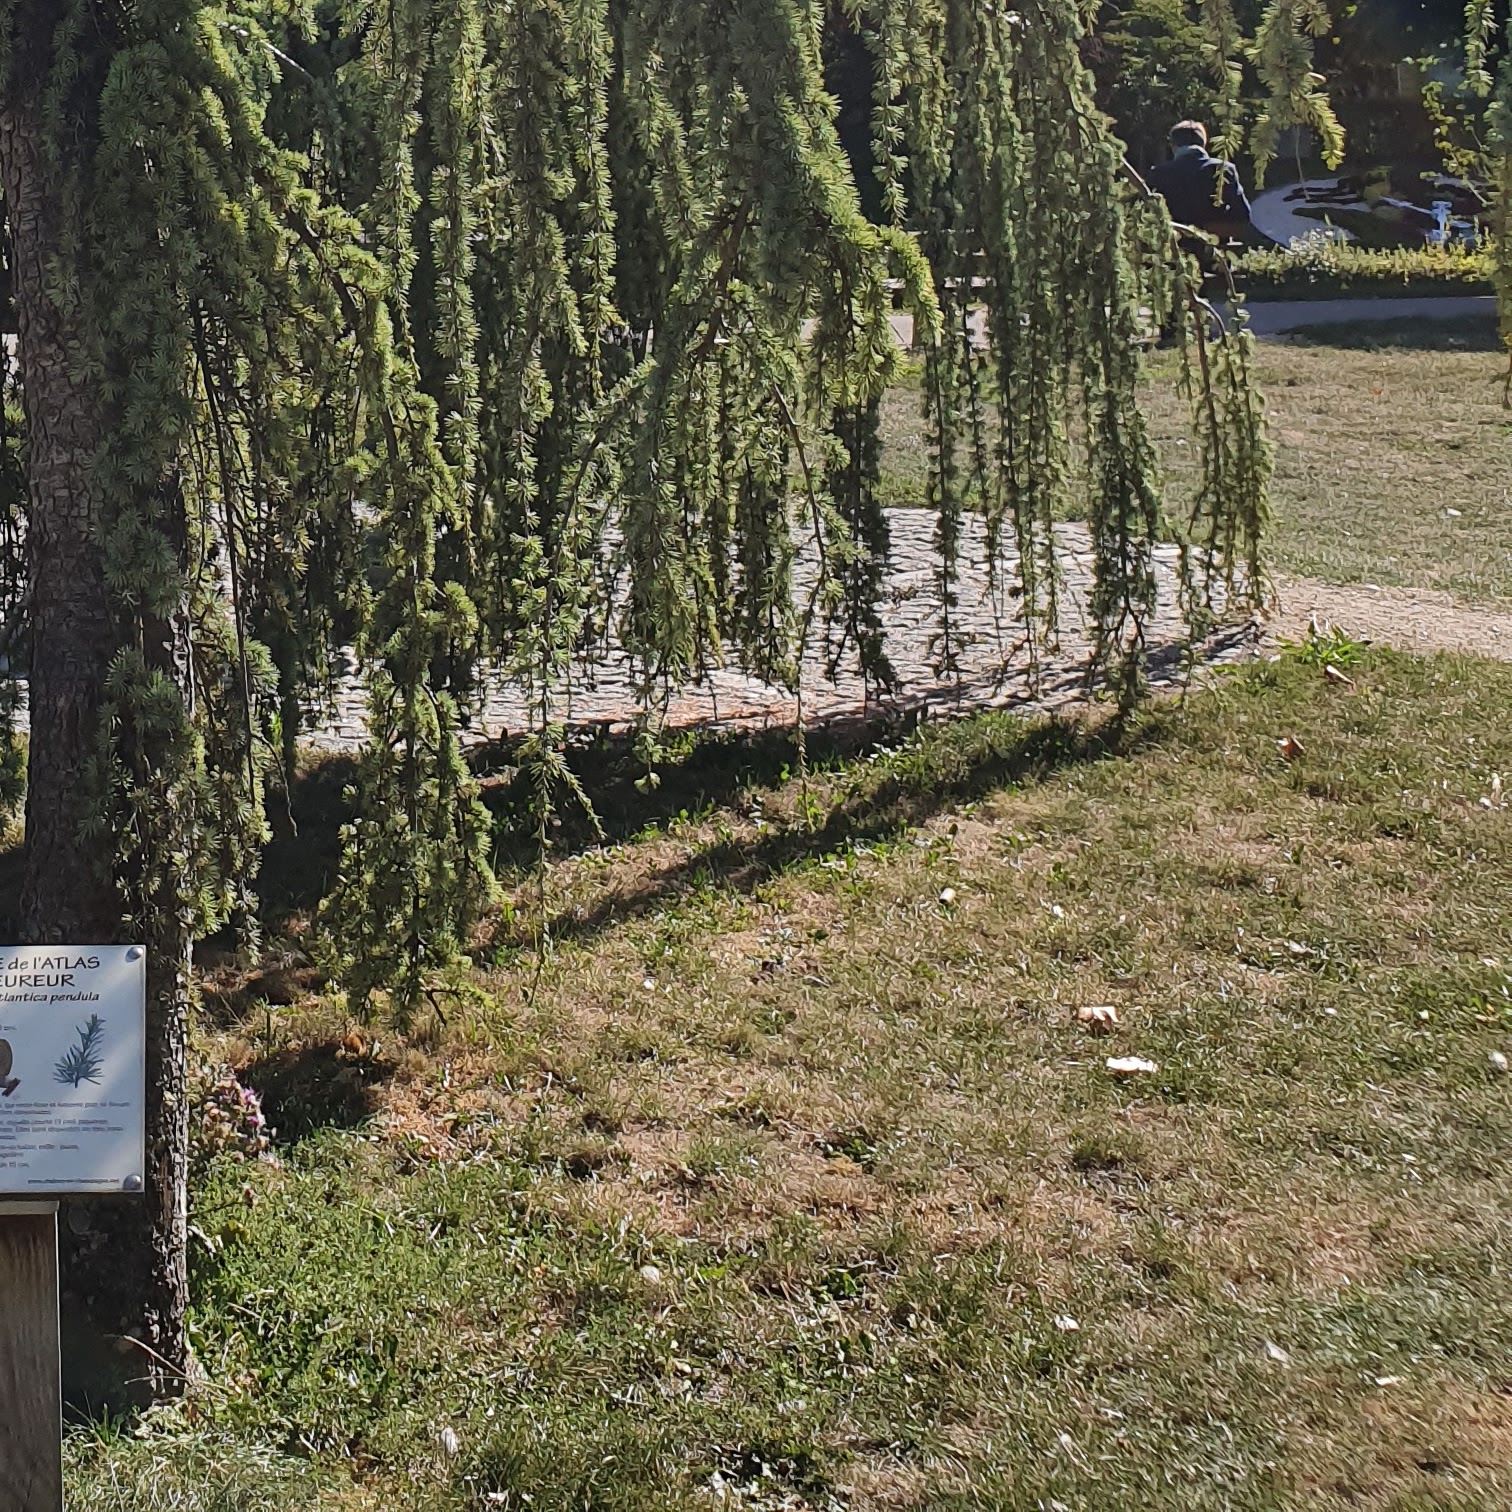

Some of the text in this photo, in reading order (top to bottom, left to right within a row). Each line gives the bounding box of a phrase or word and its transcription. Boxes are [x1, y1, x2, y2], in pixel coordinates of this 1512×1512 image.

[8, 957, 29, 971] de
[33, 956, 100, 971] l'ATLAS
[50, 991, 100, 1005] pendula
